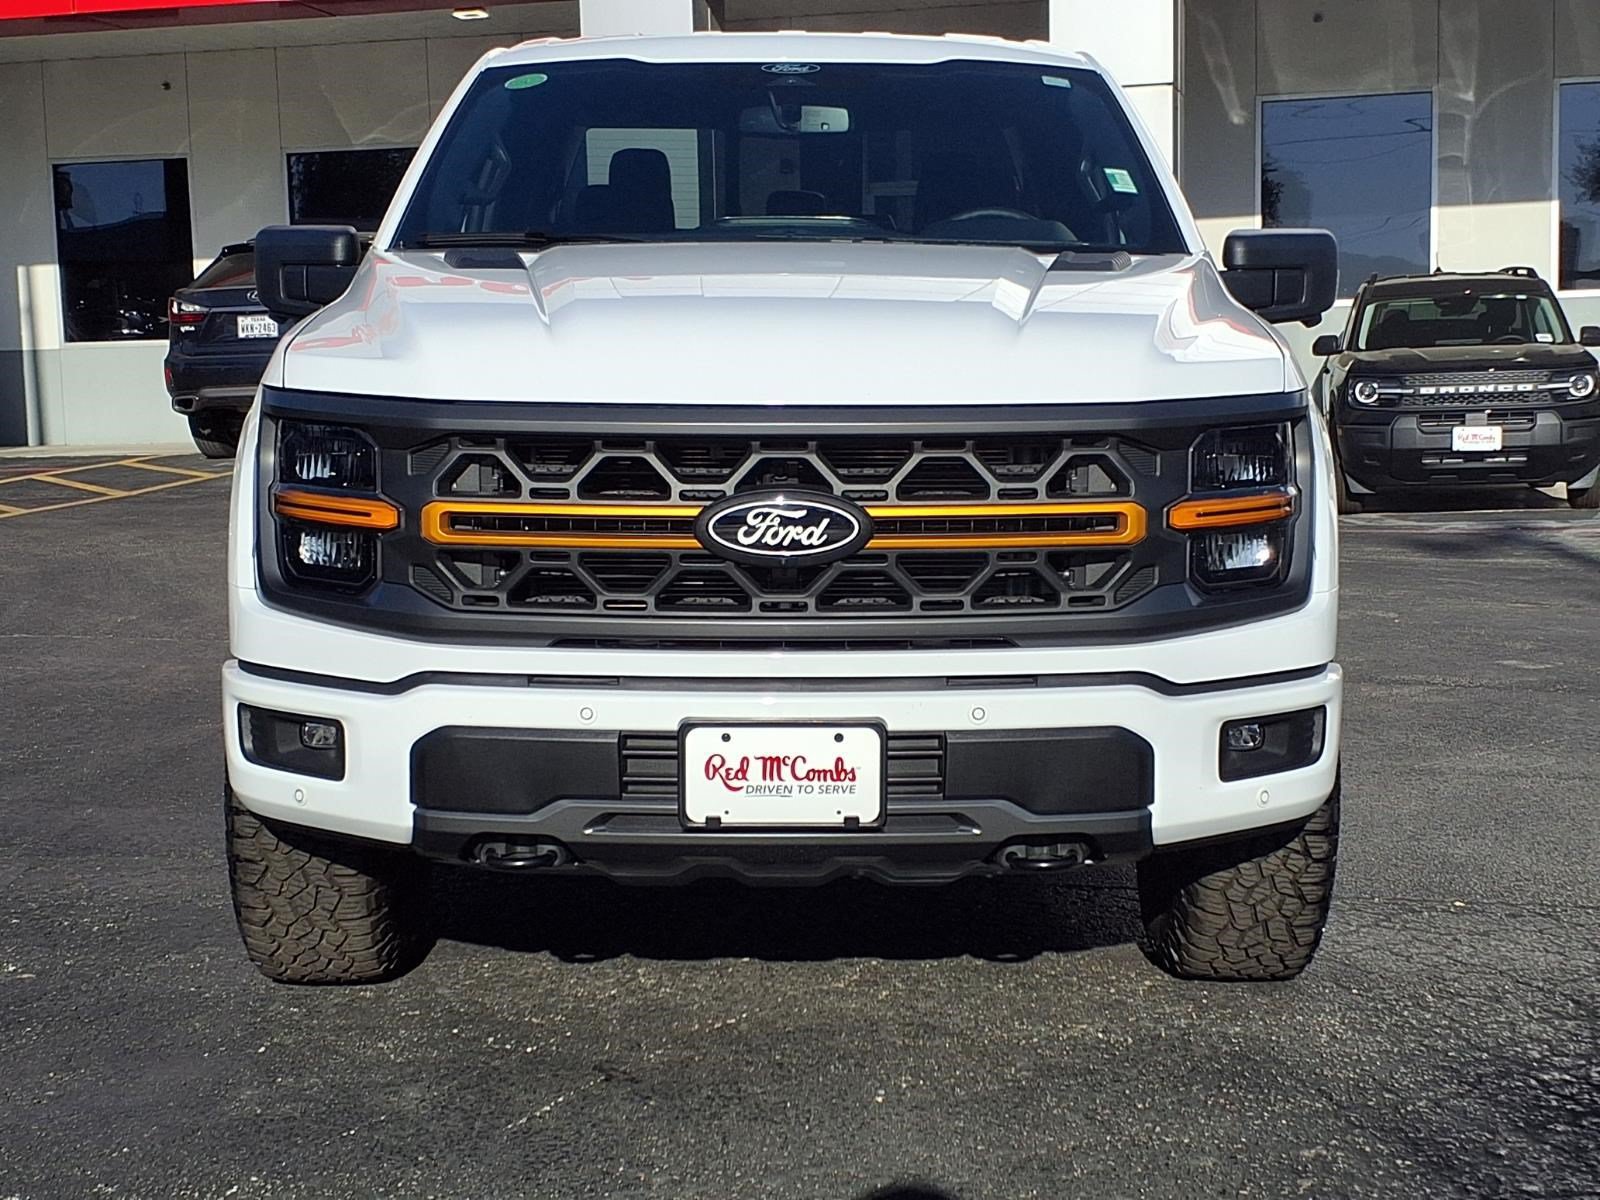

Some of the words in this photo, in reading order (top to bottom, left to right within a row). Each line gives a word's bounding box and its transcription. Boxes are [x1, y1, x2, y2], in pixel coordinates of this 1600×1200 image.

[737, 507, 831, 547] Ford
[704, 754, 750, 792] Red
[753, 755, 857, 782] McCombs
[745, 784, 793, 795] DRIVEN
[797, 784, 814, 795] TO
[817, 784, 857, 795] SERVE
